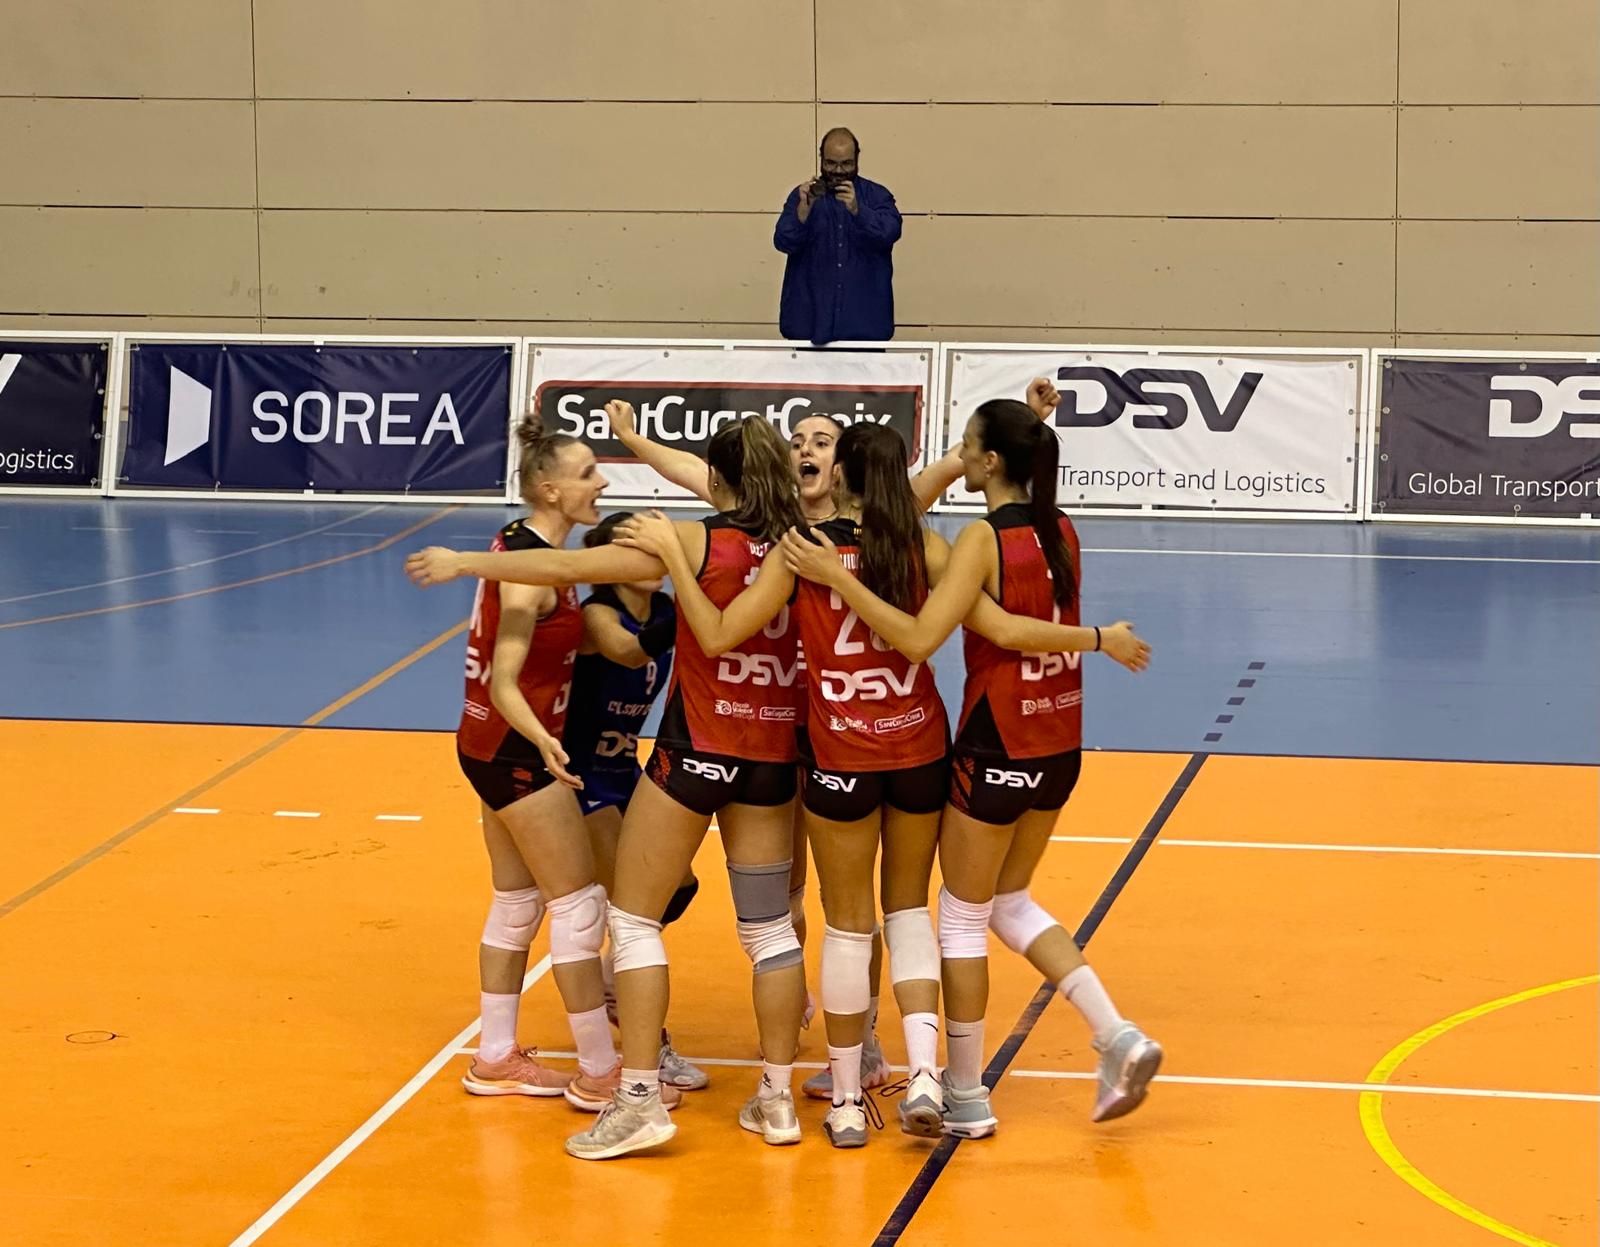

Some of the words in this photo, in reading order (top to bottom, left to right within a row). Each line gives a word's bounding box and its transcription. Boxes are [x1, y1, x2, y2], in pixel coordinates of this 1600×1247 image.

[1055, 366, 1264, 432] DSV
[251, 390, 465, 444] SOREA
[1058, 465, 1166, 492] Transport
[1174, 469, 1216, 490] and
[1224, 470, 1326, 497] Logistics
[1408, 472, 1482, 495] Global
[1491, 474, 1600, 502] Transport
[646, 661, 658, 695] 9
[718, 652, 798, 687] DSV
[1021, 651, 1081, 681] DSV
[821, 664, 920, 702] DSV
[683, 758, 739, 783] DSV
[813, 770, 857, 793] DSV
[985, 768, 1043, 788] DSV
